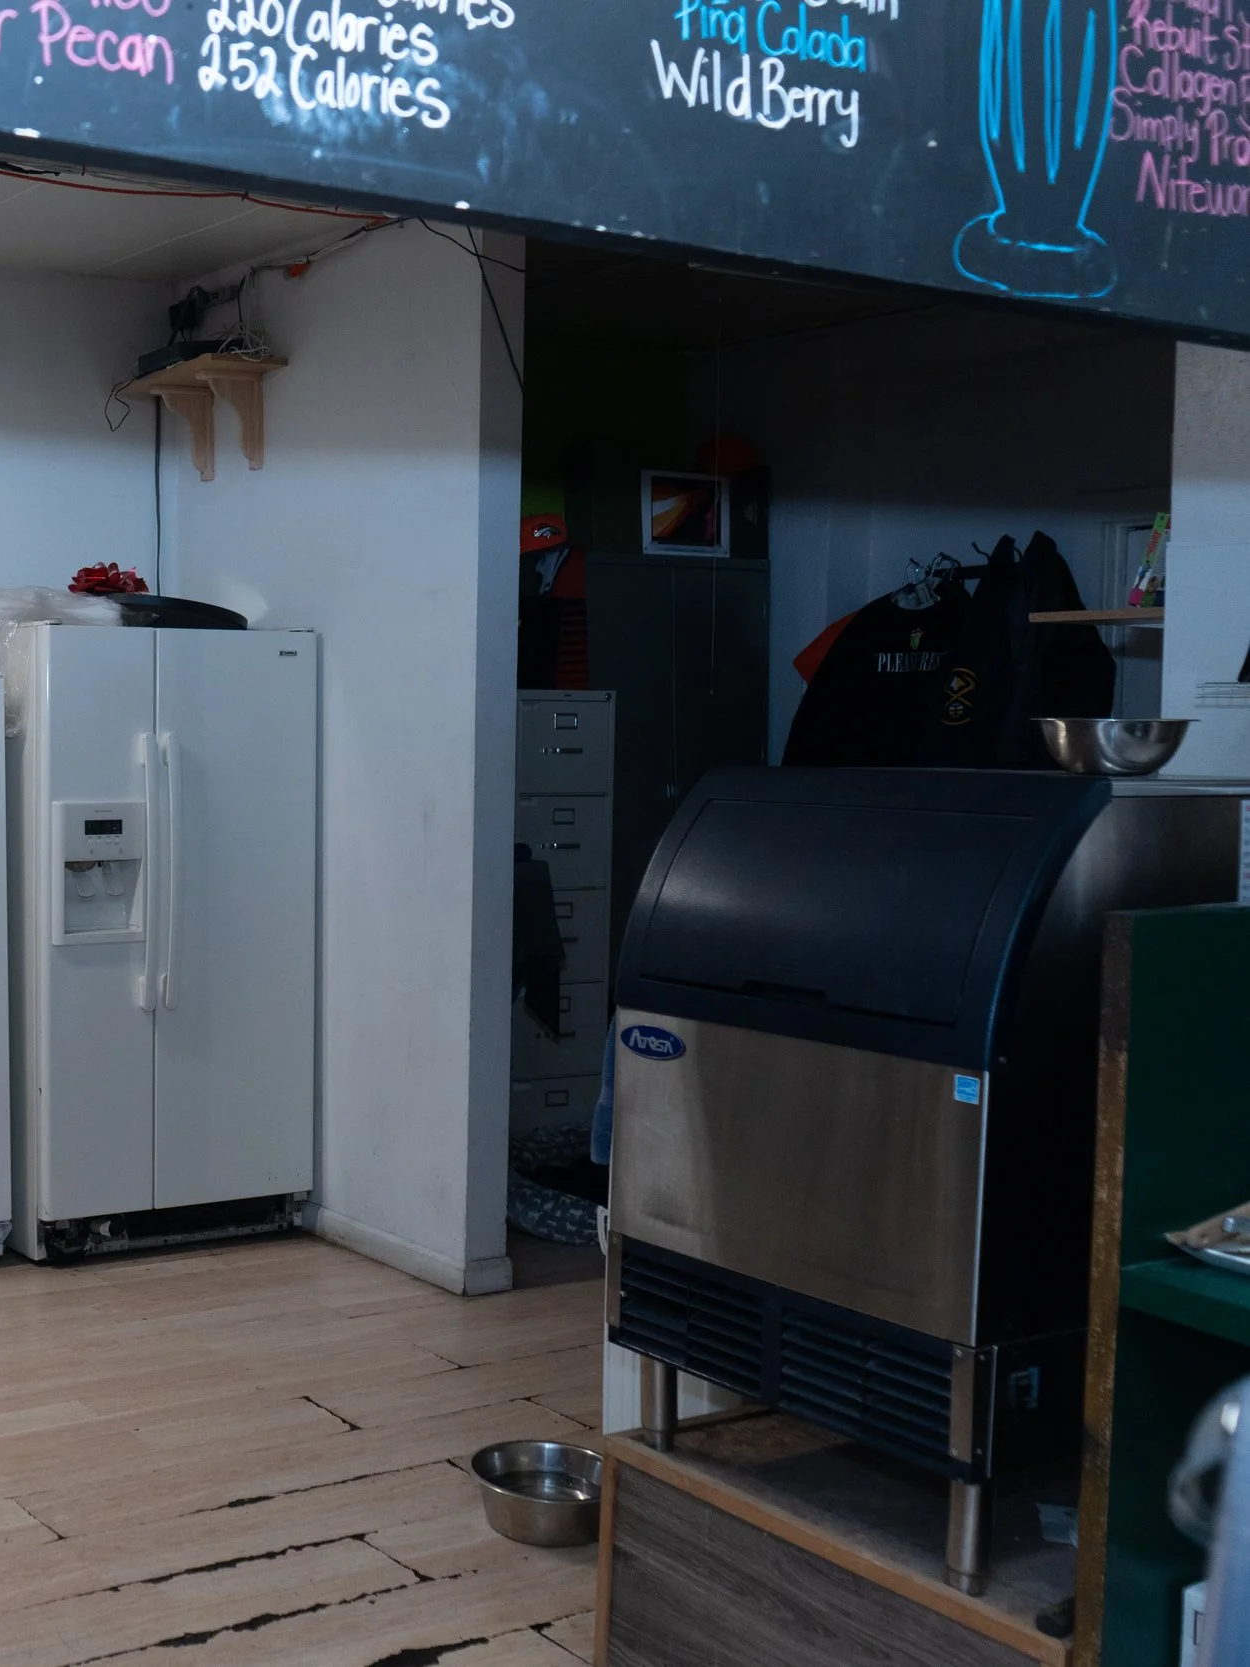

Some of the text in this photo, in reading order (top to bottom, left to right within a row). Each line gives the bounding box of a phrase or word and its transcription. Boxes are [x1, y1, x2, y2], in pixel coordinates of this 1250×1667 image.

[31, 0, 174, 84] Pecan
[285, 0, 439, 66] Calories
[756, 0, 866, 73] Colada
[198, 33, 451, 128] 252 Calories
[650, 39, 859, 148] Wild Berry
[1119, 44, 1237, 116] Collagen
[1110, 87, 1199, 163] Simply
